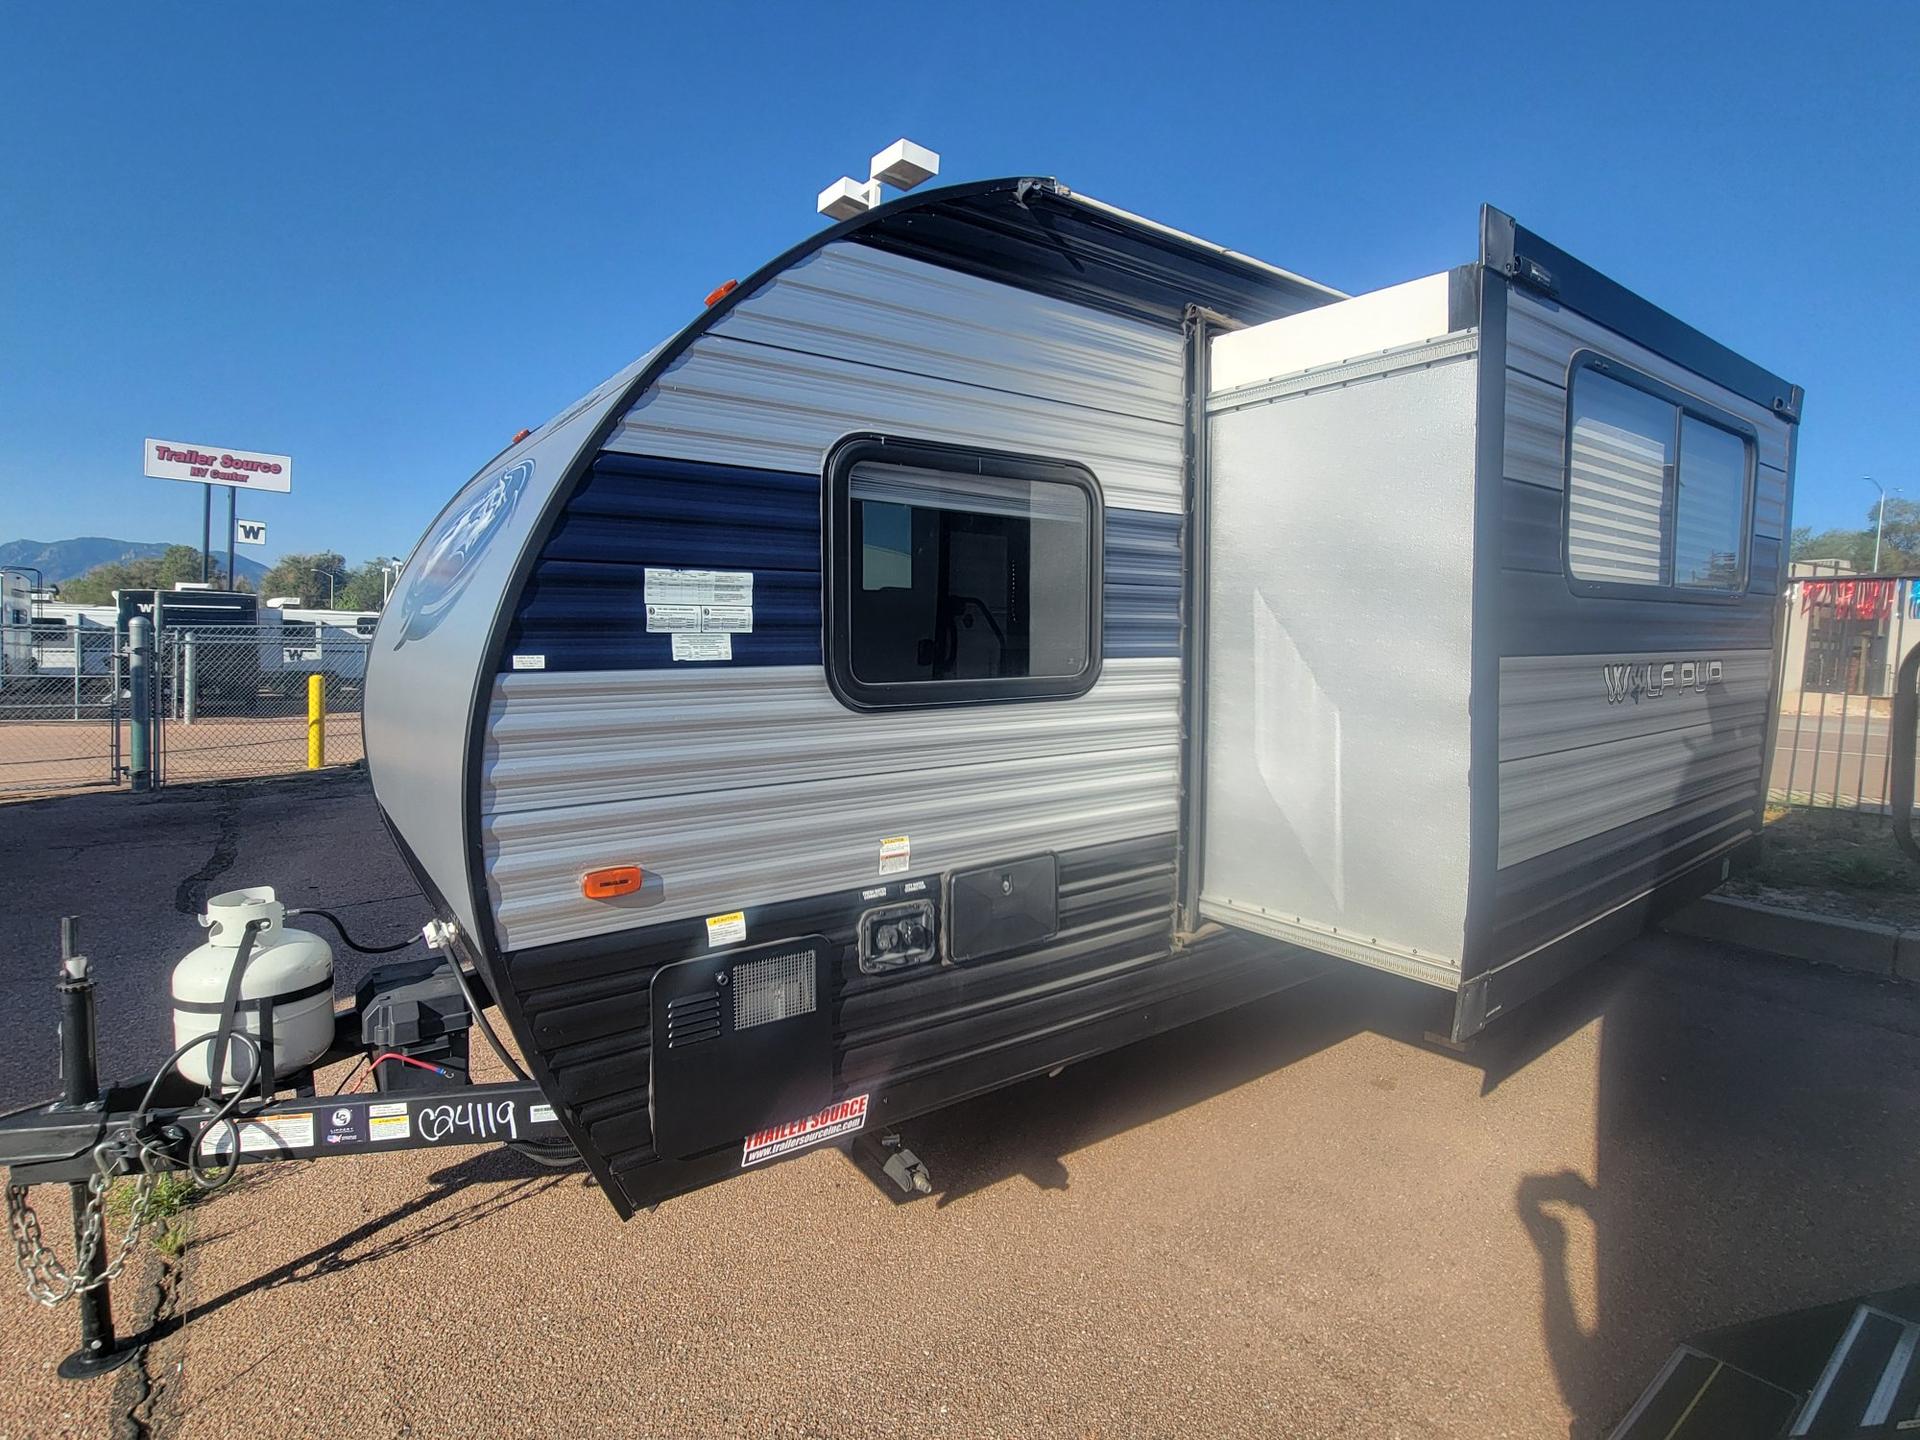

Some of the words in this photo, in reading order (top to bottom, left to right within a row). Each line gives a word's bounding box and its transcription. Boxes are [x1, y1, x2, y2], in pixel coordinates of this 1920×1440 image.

[155, 445, 217, 467] Trailer
[220, 454, 283, 475] Source
[190, 466, 209, 477] RV
[210, 469, 250, 483] Center
[746, 1117, 807, 1150] TRAILER
[812, 1098, 866, 1128] SOURCE
[748, 1118, 860, 1161] www.trailersourceinc.com
